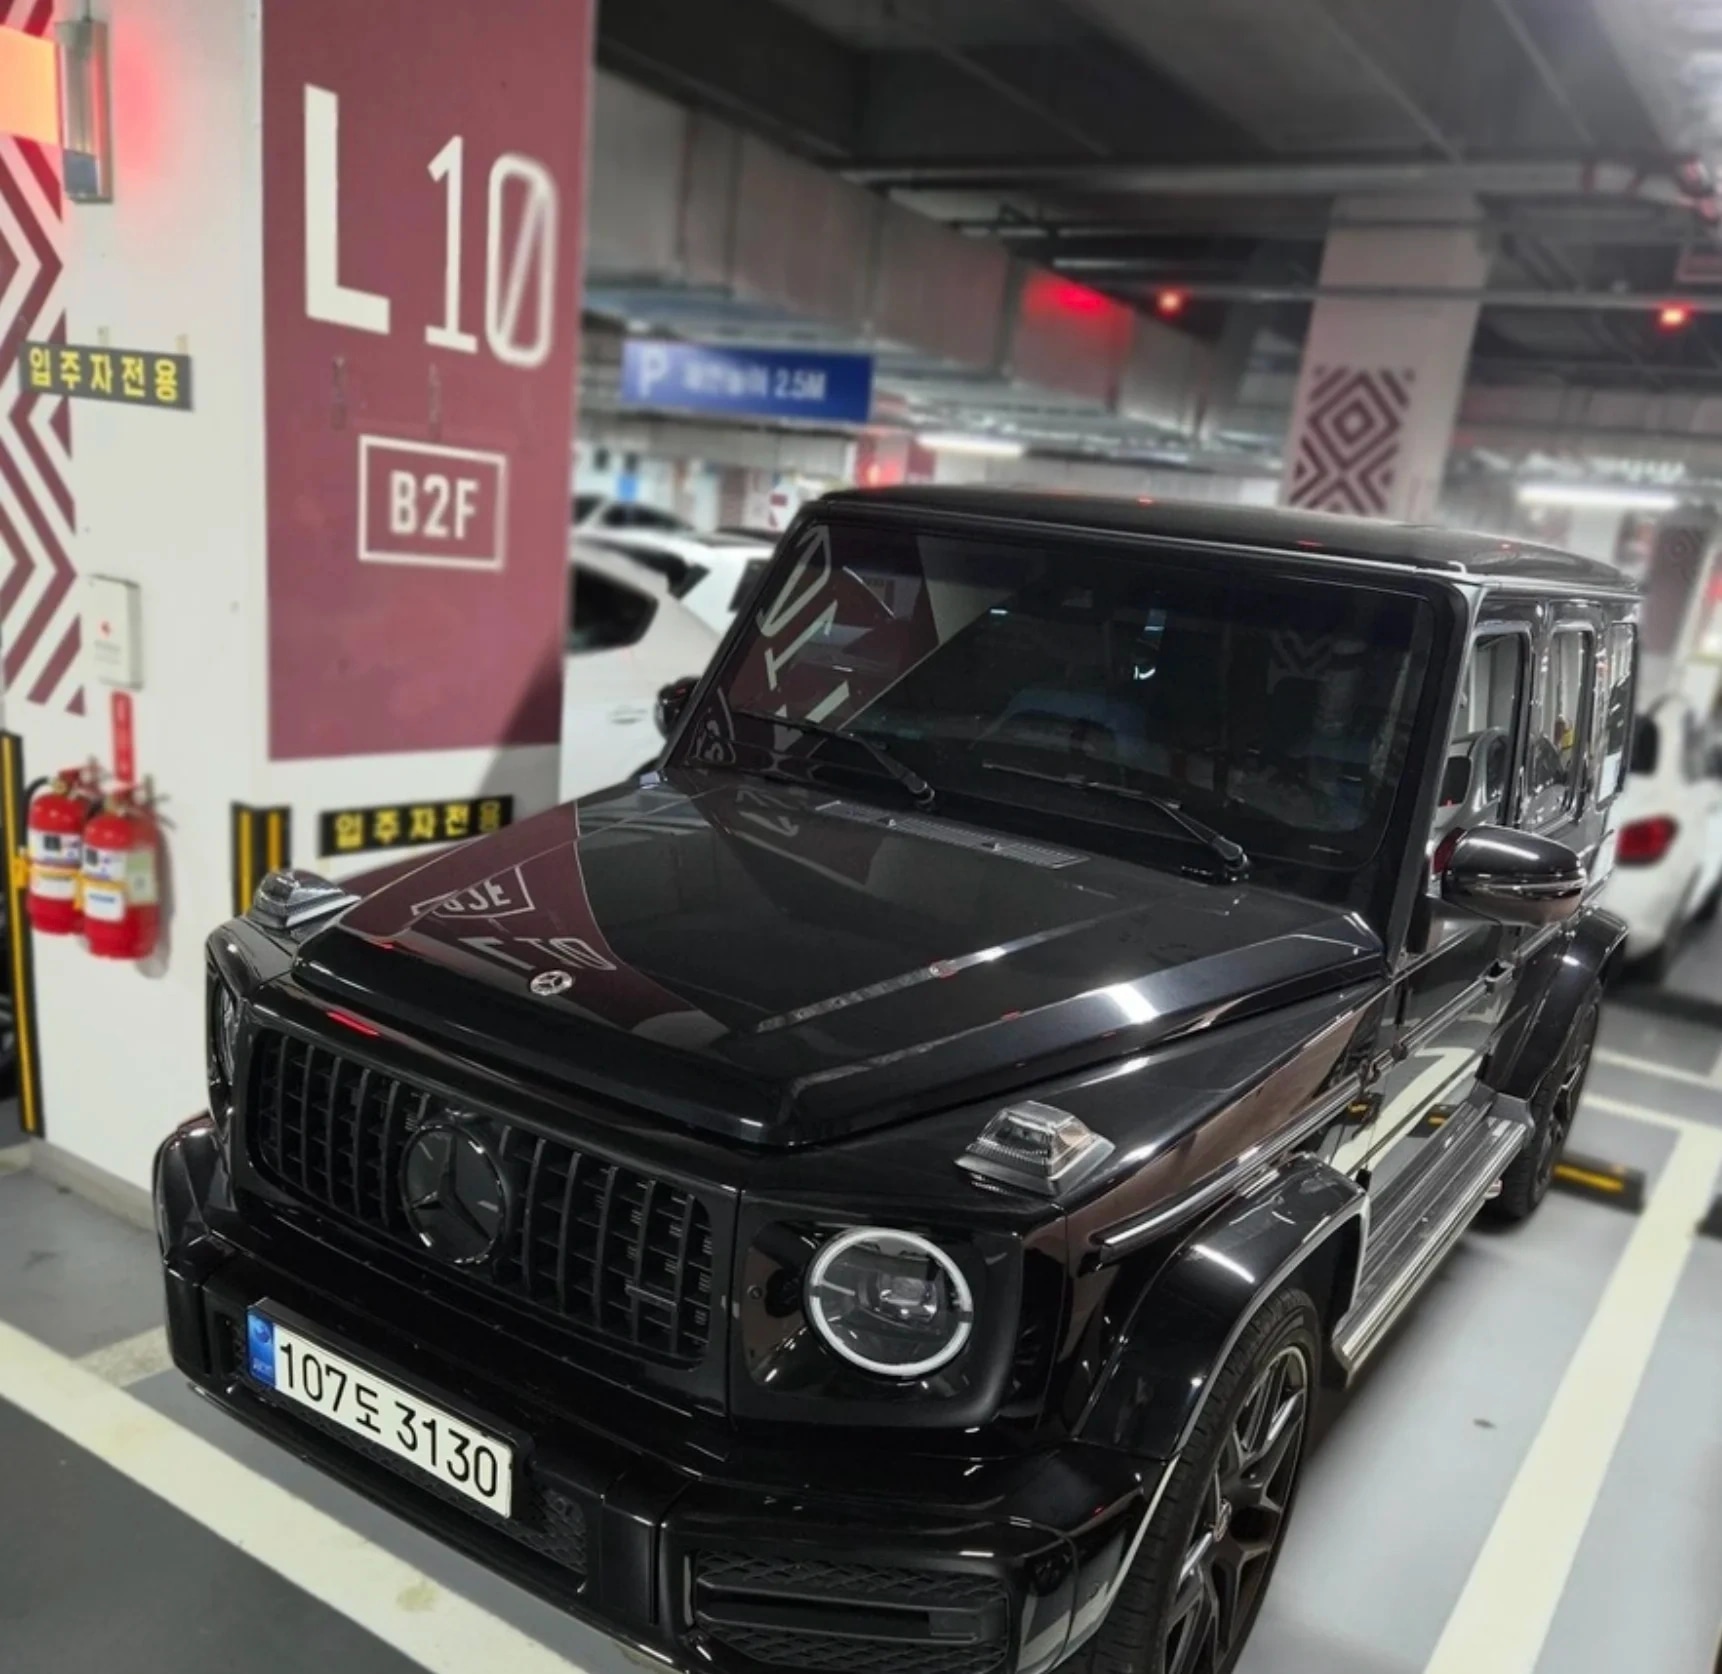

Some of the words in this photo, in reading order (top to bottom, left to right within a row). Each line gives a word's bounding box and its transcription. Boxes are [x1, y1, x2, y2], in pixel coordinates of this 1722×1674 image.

[30, 347, 178, 402] 입주자전용
[389, 470, 479, 540] B2F
[280, 1343, 382, 1434] 107도
[394, 1400, 499, 1498] 3130
